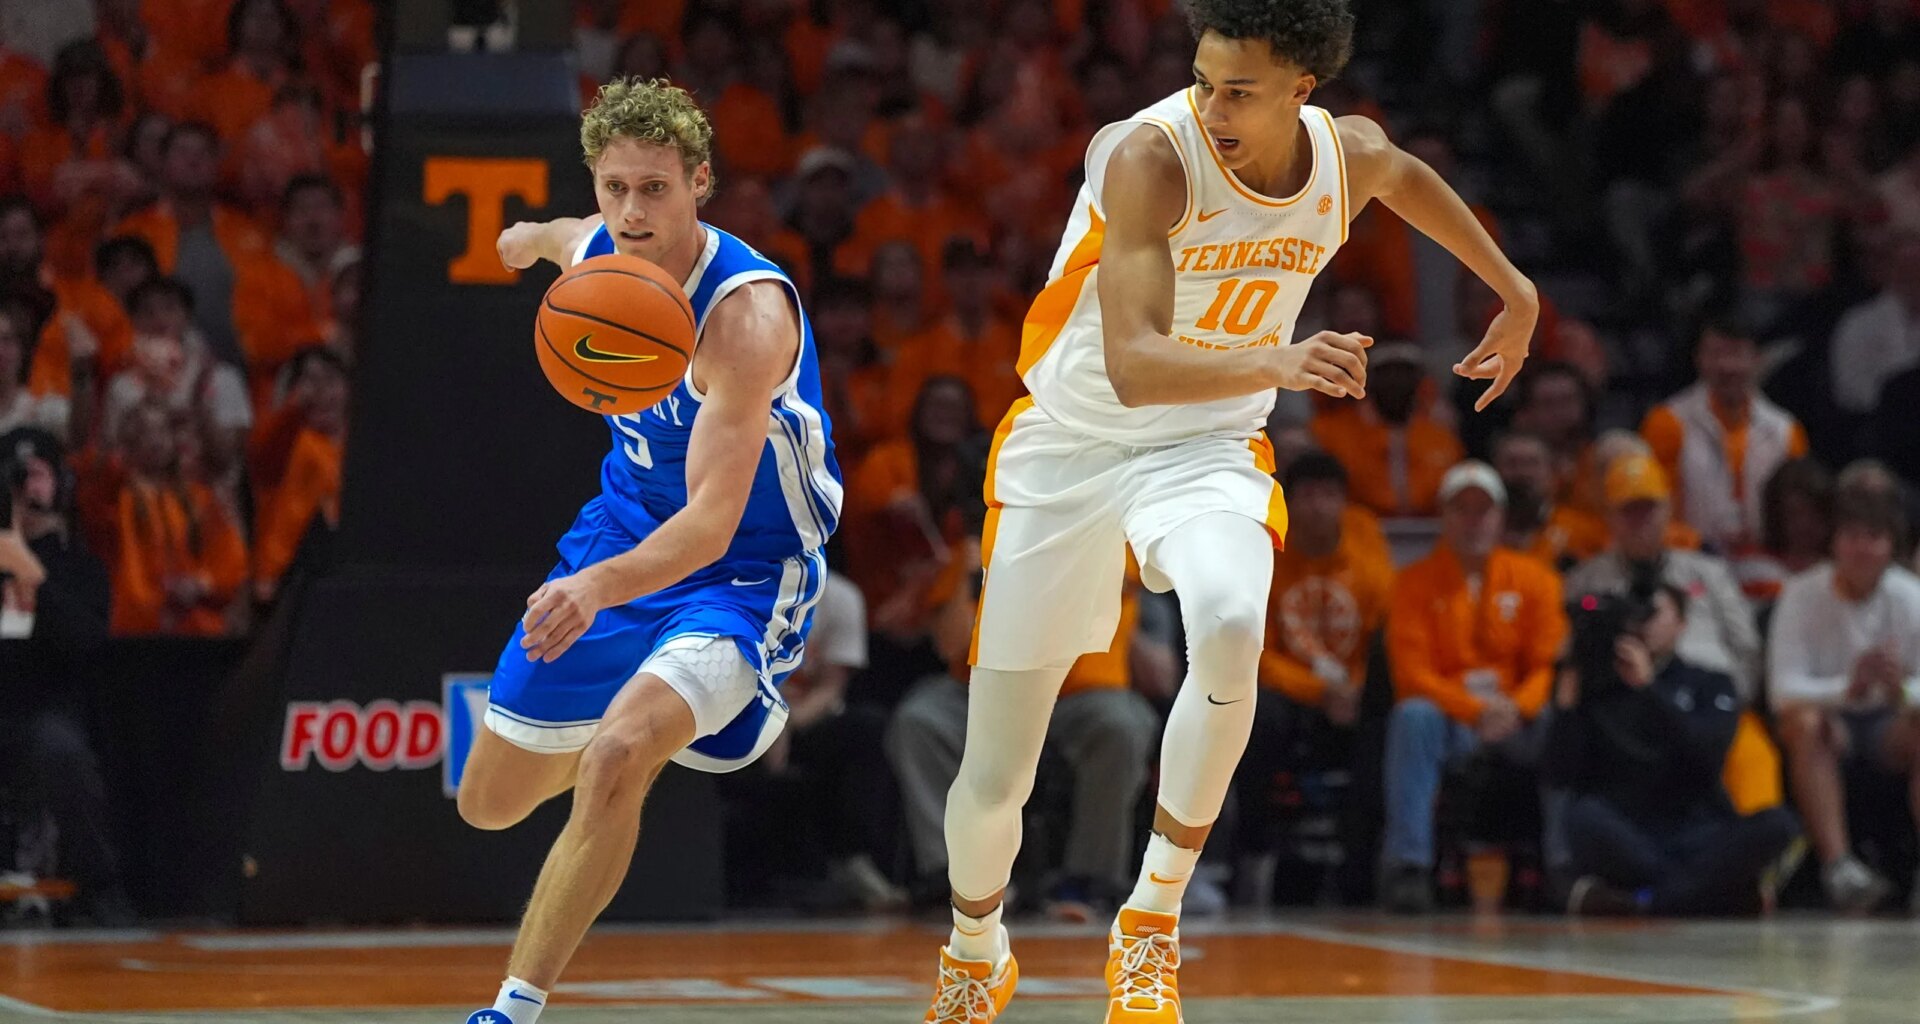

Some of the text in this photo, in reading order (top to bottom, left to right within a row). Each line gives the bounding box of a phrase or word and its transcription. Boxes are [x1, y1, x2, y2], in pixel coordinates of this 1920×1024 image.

[424, 157, 549, 284] T
[1176, 237, 1326, 276] TENNESSEE
[1194, 277, 1280, 336] 10
[581, 387, 618, 411] T
[611, 412, 654, 470] 5
[284, 703, 443, 768] FOOD
